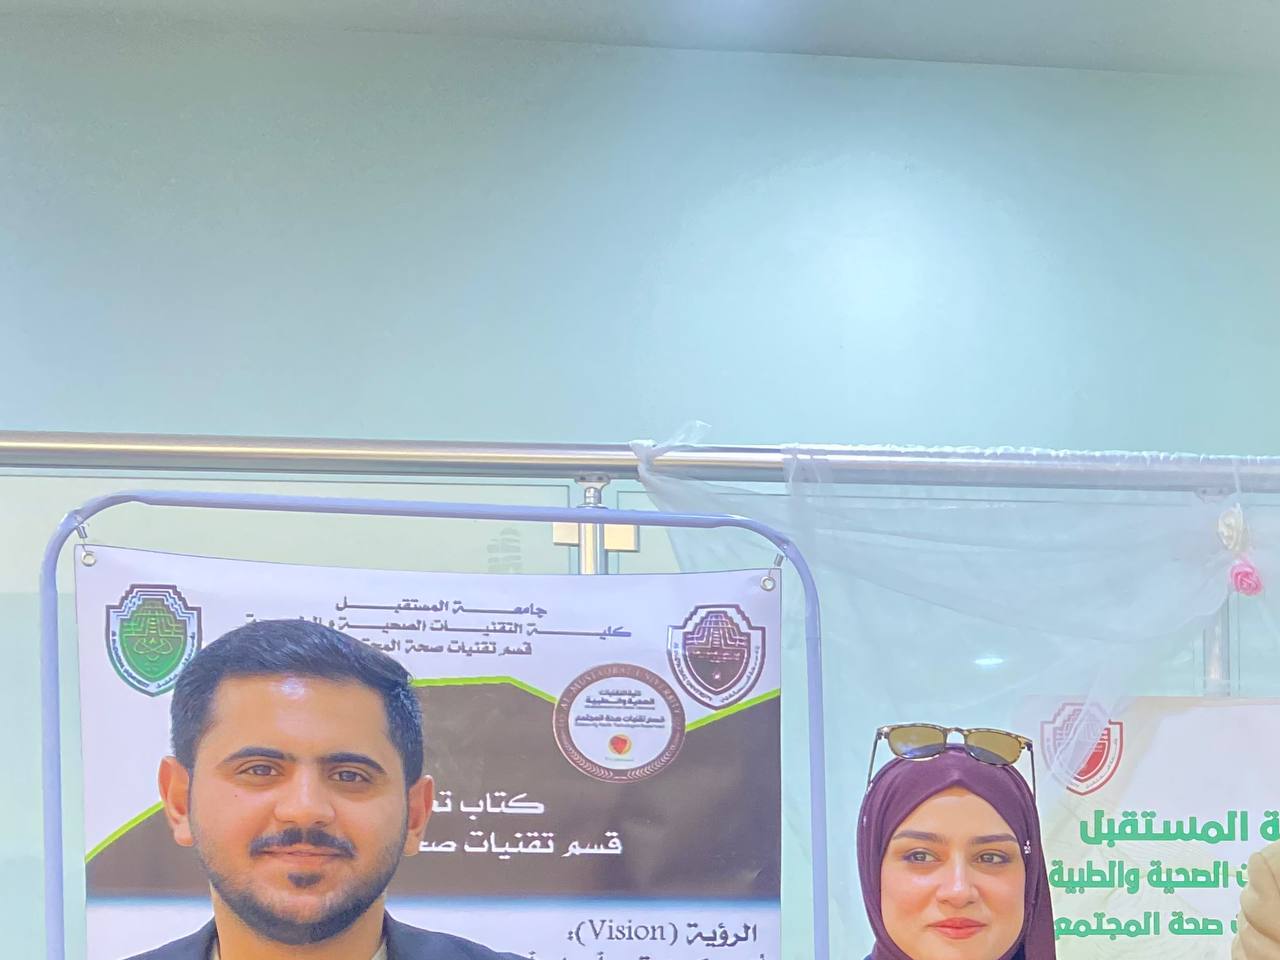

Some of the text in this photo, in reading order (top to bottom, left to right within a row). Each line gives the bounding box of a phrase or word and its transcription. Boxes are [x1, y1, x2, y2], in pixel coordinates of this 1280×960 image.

[405, 639, 532, 658] قسم تقنيات صحة
[460, 791, 545, 821] كتاب
[1080, 809, 1249, 848] المستقبل
[464, 831, 554, 860] تقنيات
[562, 831, 624, 858] قسم
[1049, 860, 1140, 894] والطبية
[1147, 860, 1229, 894] الصحية
[686, 921, 757, 948] الرؤية
[1053, 911, 1224, 941] صحة المجتمع
